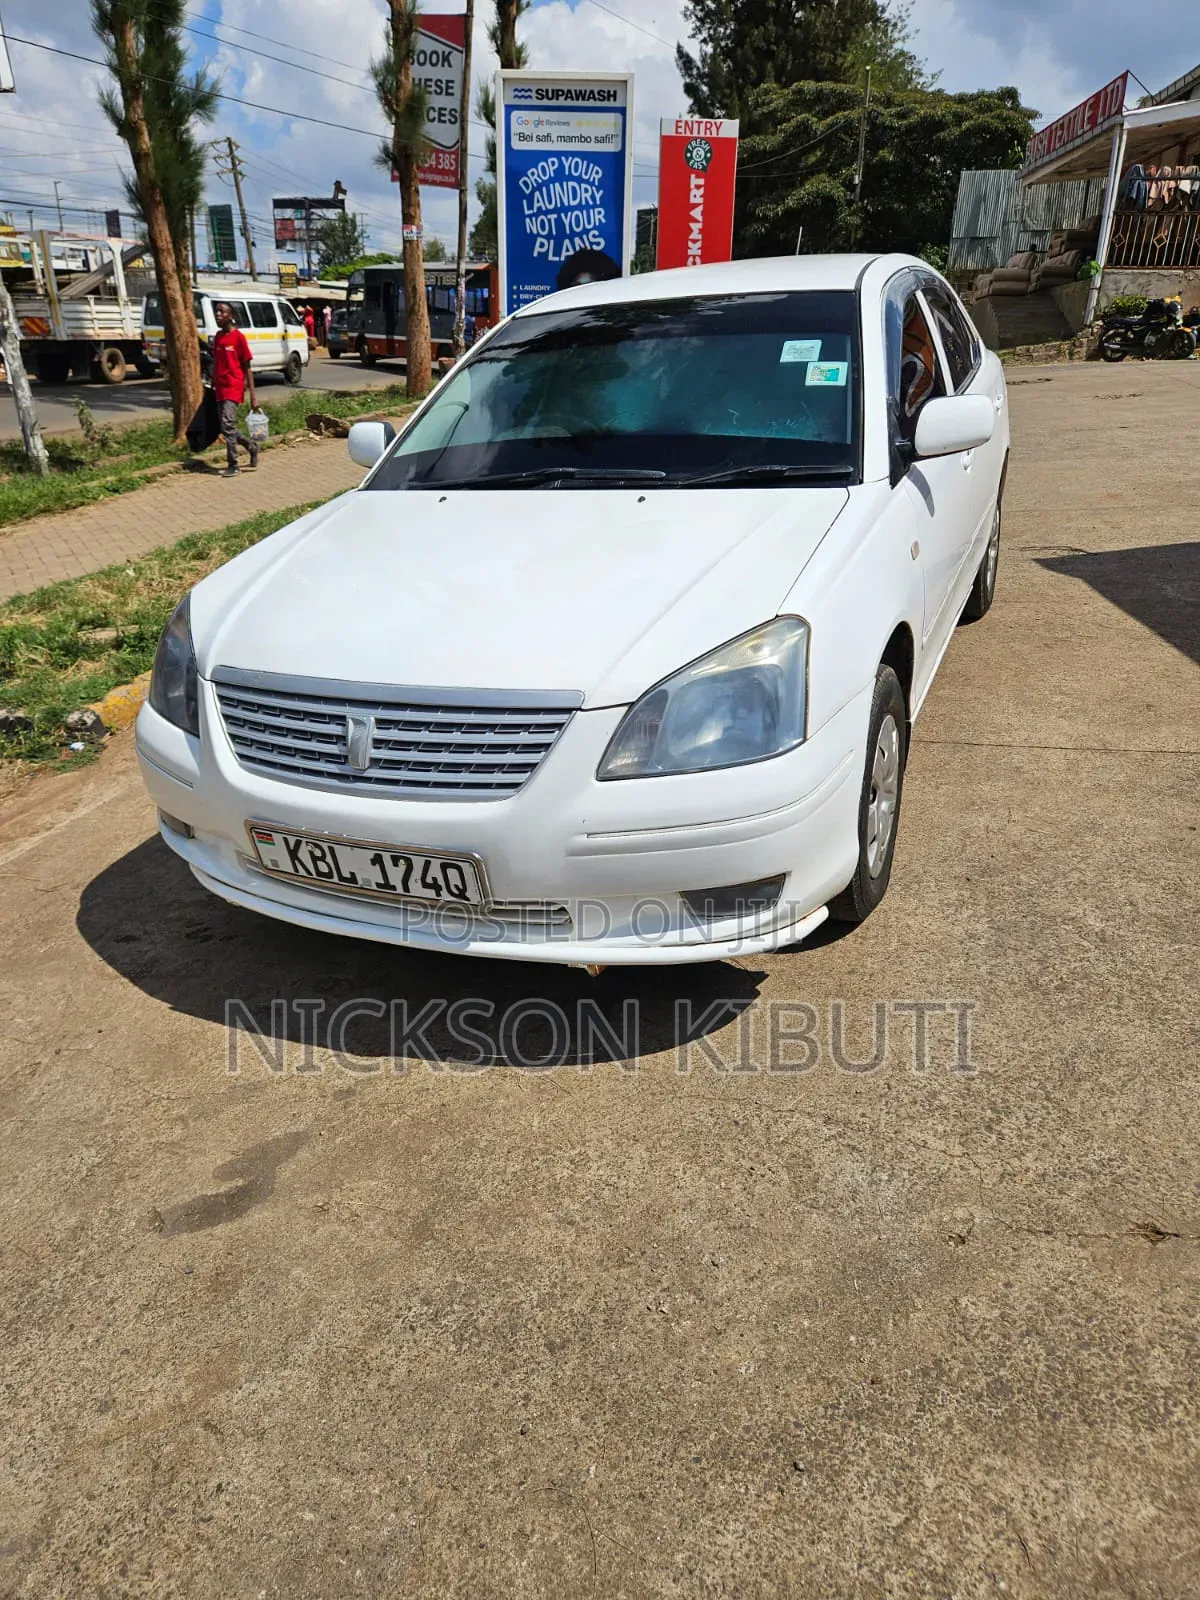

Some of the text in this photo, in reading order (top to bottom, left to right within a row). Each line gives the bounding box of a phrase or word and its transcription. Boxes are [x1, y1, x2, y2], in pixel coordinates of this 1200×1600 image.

[535, 88, 617, 102] SUPAWASH
[516, 116, 545, 128] Google
[1050, 97, 1096, 153] TEXTILE
[1096, 77, 1124, 123] LTD
[556, 134, 592, 144] mambo
[675, 119, 724, 136] ENTRY
[687, 138, 711, 151] FRESH
[437, 153, 456, 171] 385
[688, 159, 708, 170] EASY
[518, 156, 603, 195] DROP YOUR
[522, 181, 604, 215] LAUNDRY
[525, 207, 606, 236] NOT YOUR
[687, 173, 705, 268] CKMART
[533, 230, 606, 262] PLANS
[283, 836, 471, 901] KBL 174Q
